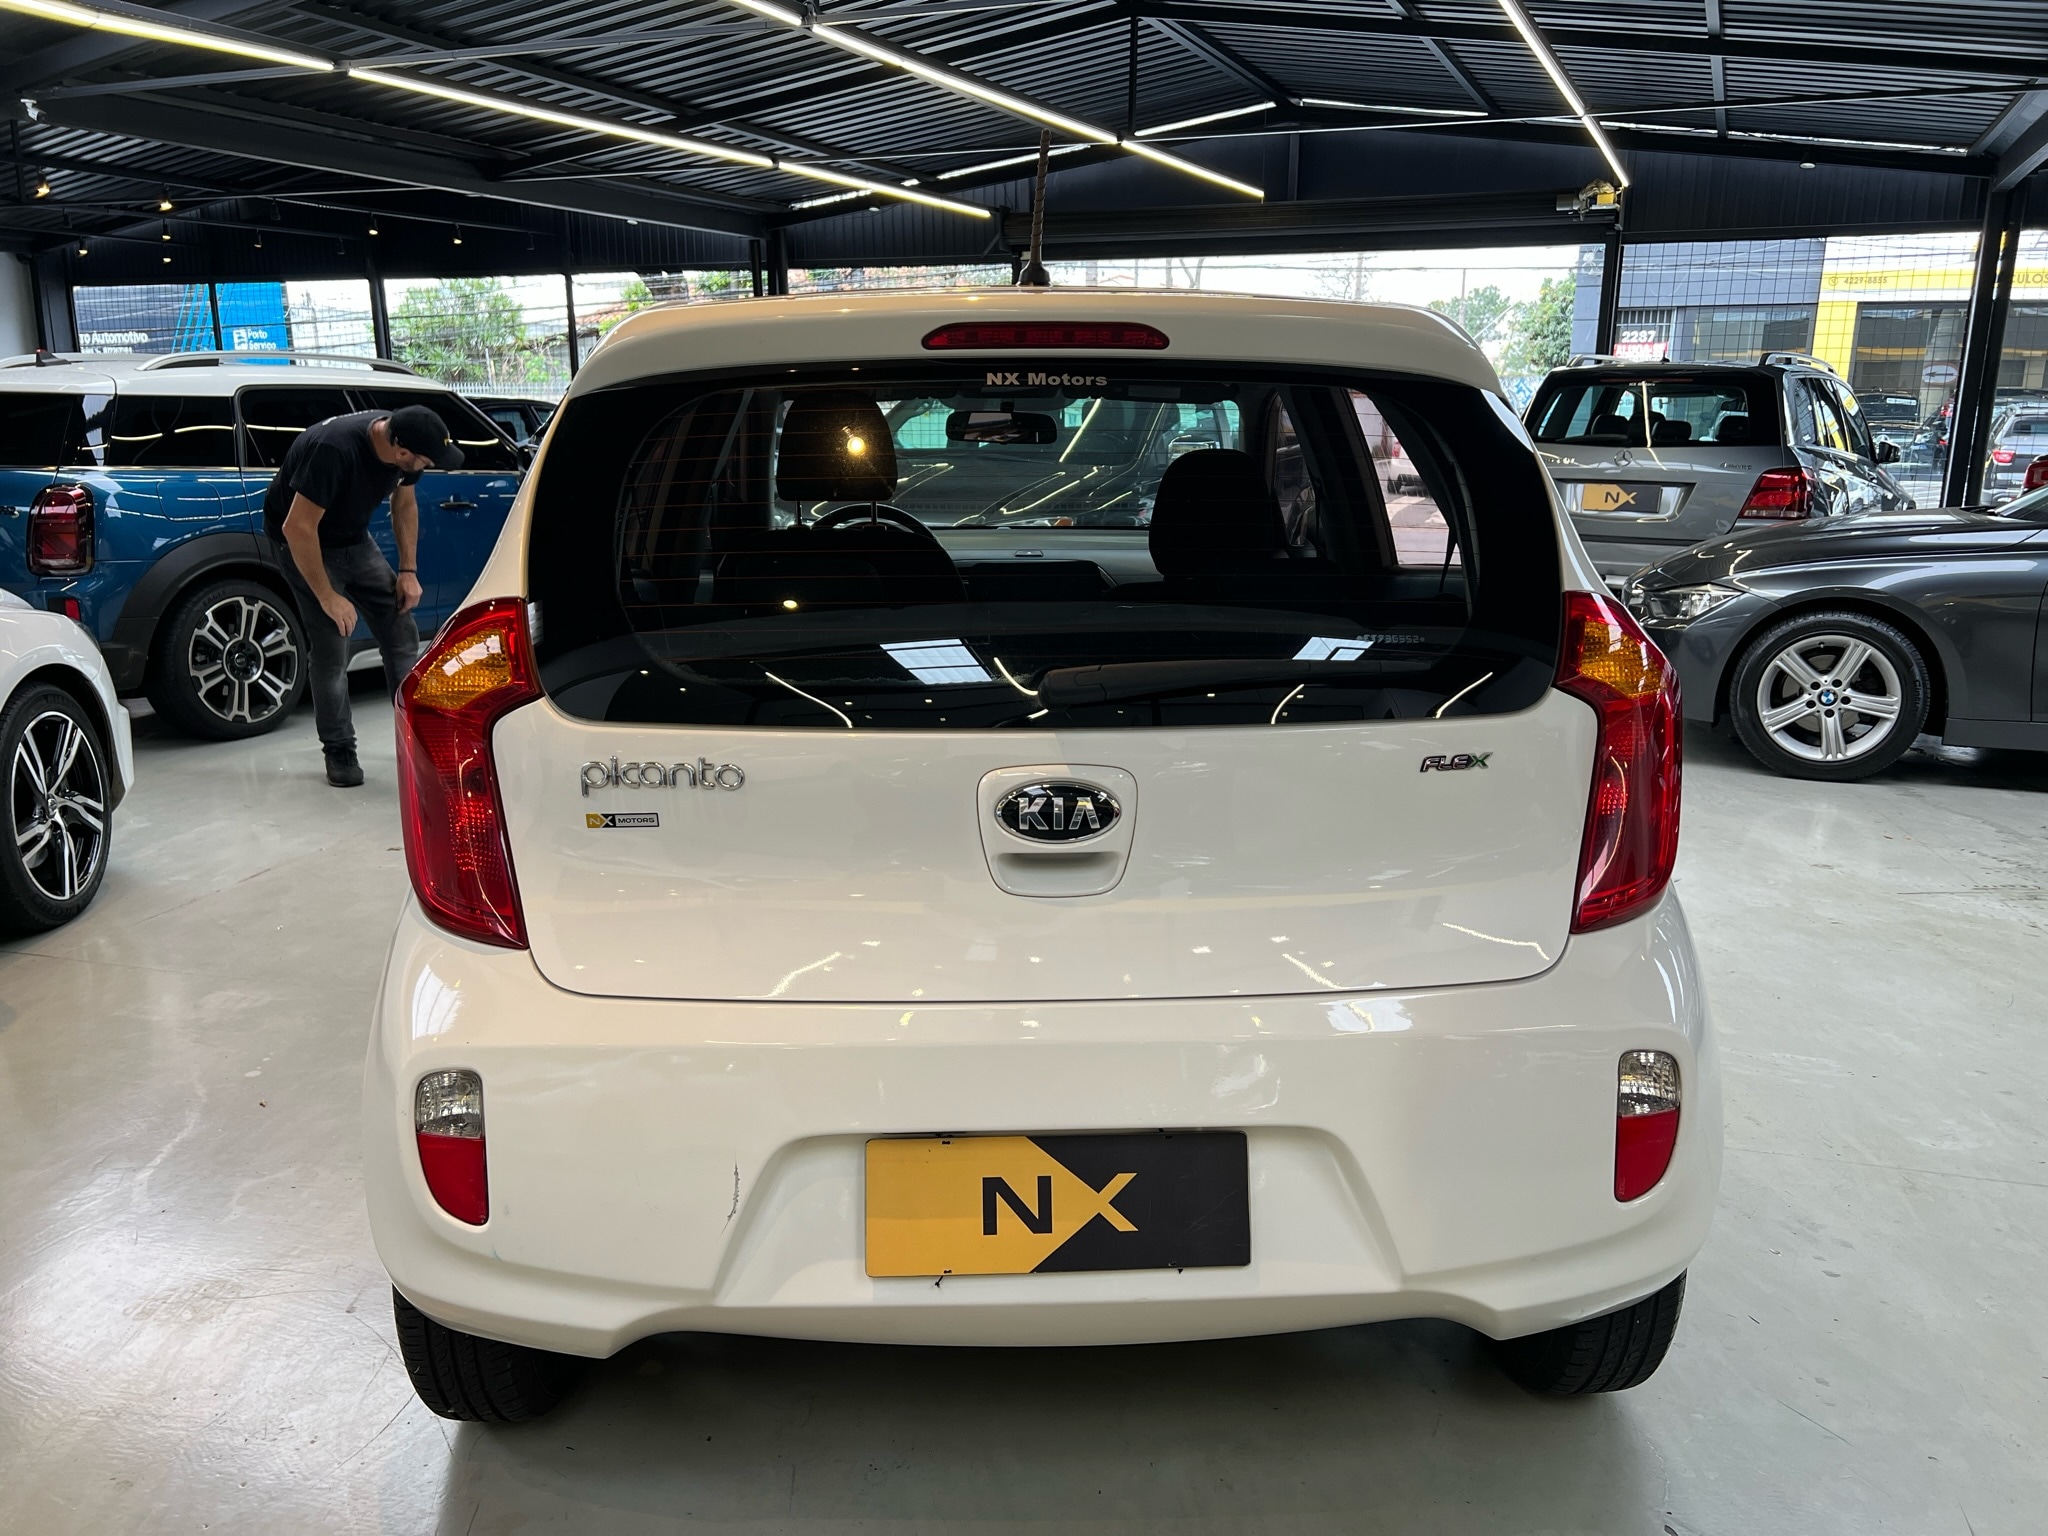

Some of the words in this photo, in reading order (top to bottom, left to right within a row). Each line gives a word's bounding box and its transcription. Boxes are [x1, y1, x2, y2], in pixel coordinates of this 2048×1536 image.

[92, 331, 149, 344] Automotivo
[248, 329, 268, 340] Porto
[987, 372, 1021, 386] NX
[1028, 372, 1108, 386] Motors
[1604, 490, 1638, 506] NX
[1420, 752, 1494, 773] FLEX
[580, 755, 746, 798] picanto
[588, 814, 615, 827] NX
[617, 816, 655, 825] MOTORS
[1017, 796, 1101, 831] KIA
[981, 1172, 1139, 1236] NX
